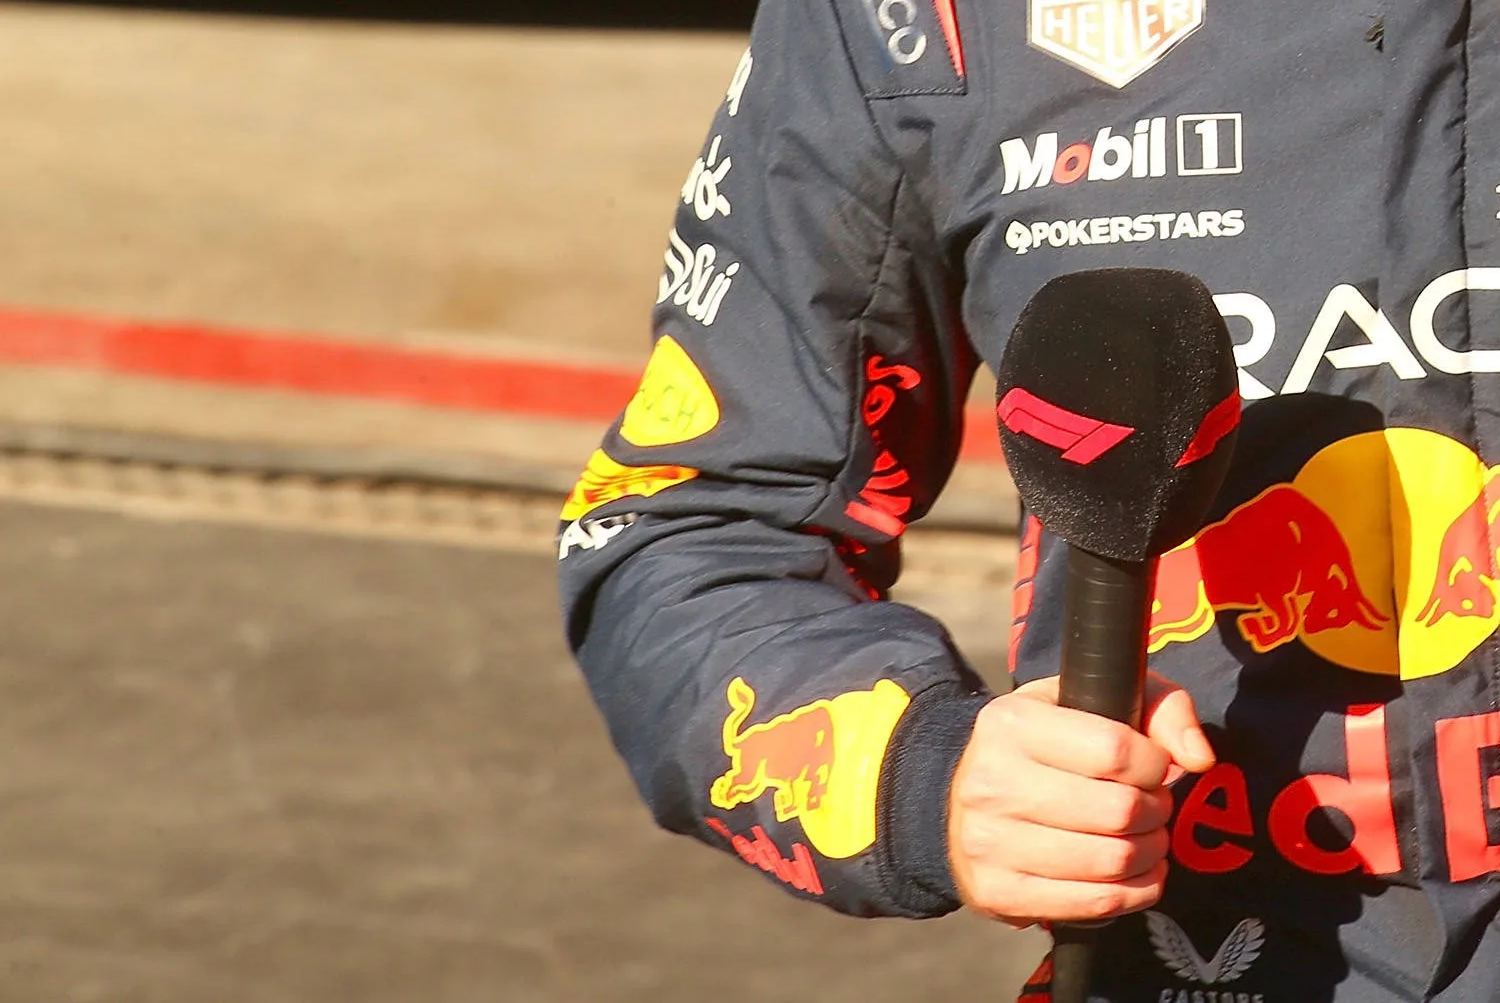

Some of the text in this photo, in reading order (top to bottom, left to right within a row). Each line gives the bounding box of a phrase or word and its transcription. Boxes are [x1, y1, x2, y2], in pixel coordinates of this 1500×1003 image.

[1000, 117, 1166, 194] Mobil
[1031, 210, 1245, 249] POKERSTARS
[1170, 702, 1401, 876] ed
